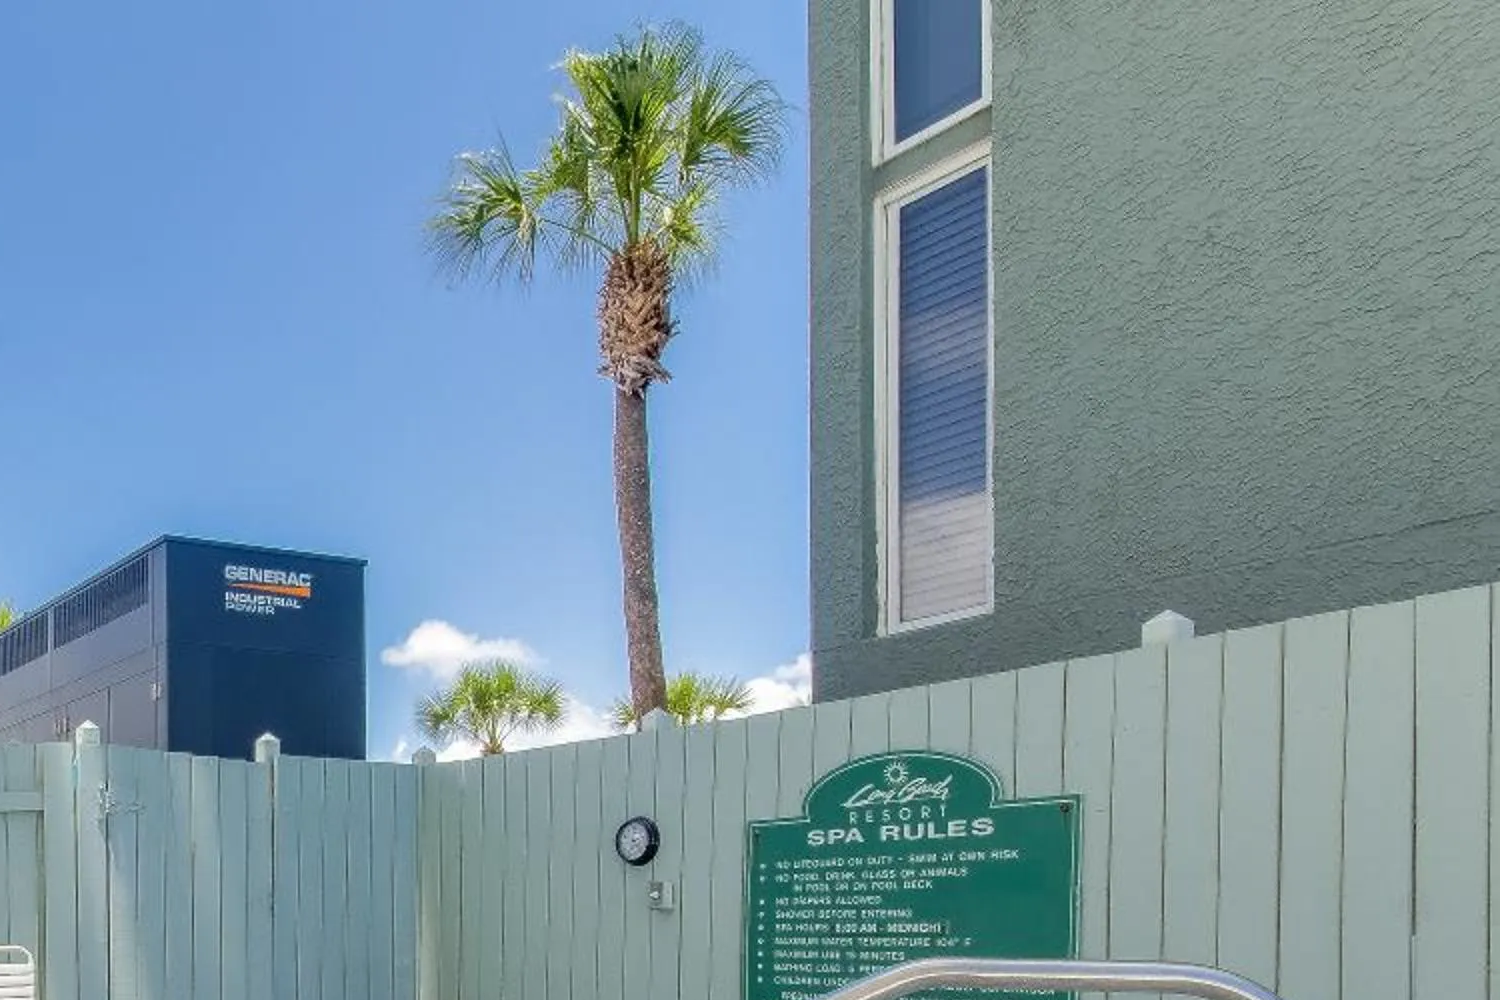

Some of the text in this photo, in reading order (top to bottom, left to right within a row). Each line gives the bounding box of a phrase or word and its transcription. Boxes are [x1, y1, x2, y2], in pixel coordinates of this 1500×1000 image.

[224, 565, 311, 587] GENERAC
[225, 592, 301, 608] INDUSTRIAL
[225, 602, 275, 615] POWER
[849, 804, 947, 824] RESORT
[806, 817, 995, 846] SPA RULES
[793, 857, 845, 869] LIFEGUARD
[867, 855, 894, 865] DUTY
[941, 851, 954, 862] AT
[990, 849, 1019, 860] RISK
[861, 869, 896, 879] GLASS
[919, 866, 969, 878] ANIMALS
[903, 879, 933, 889] DECK
[835, 895, 882, 905] ALLOWED
[818, 909, 857, 919] BEFORE
[861, 909, 913, 919] ENTERING
[859, 923, 877, 933] AM
[887, 922, 942, 933] MIDNIGHT
[858, 937, 931, 947] TEMPERATURE
[859, 951, 905, 961] MINUTES
